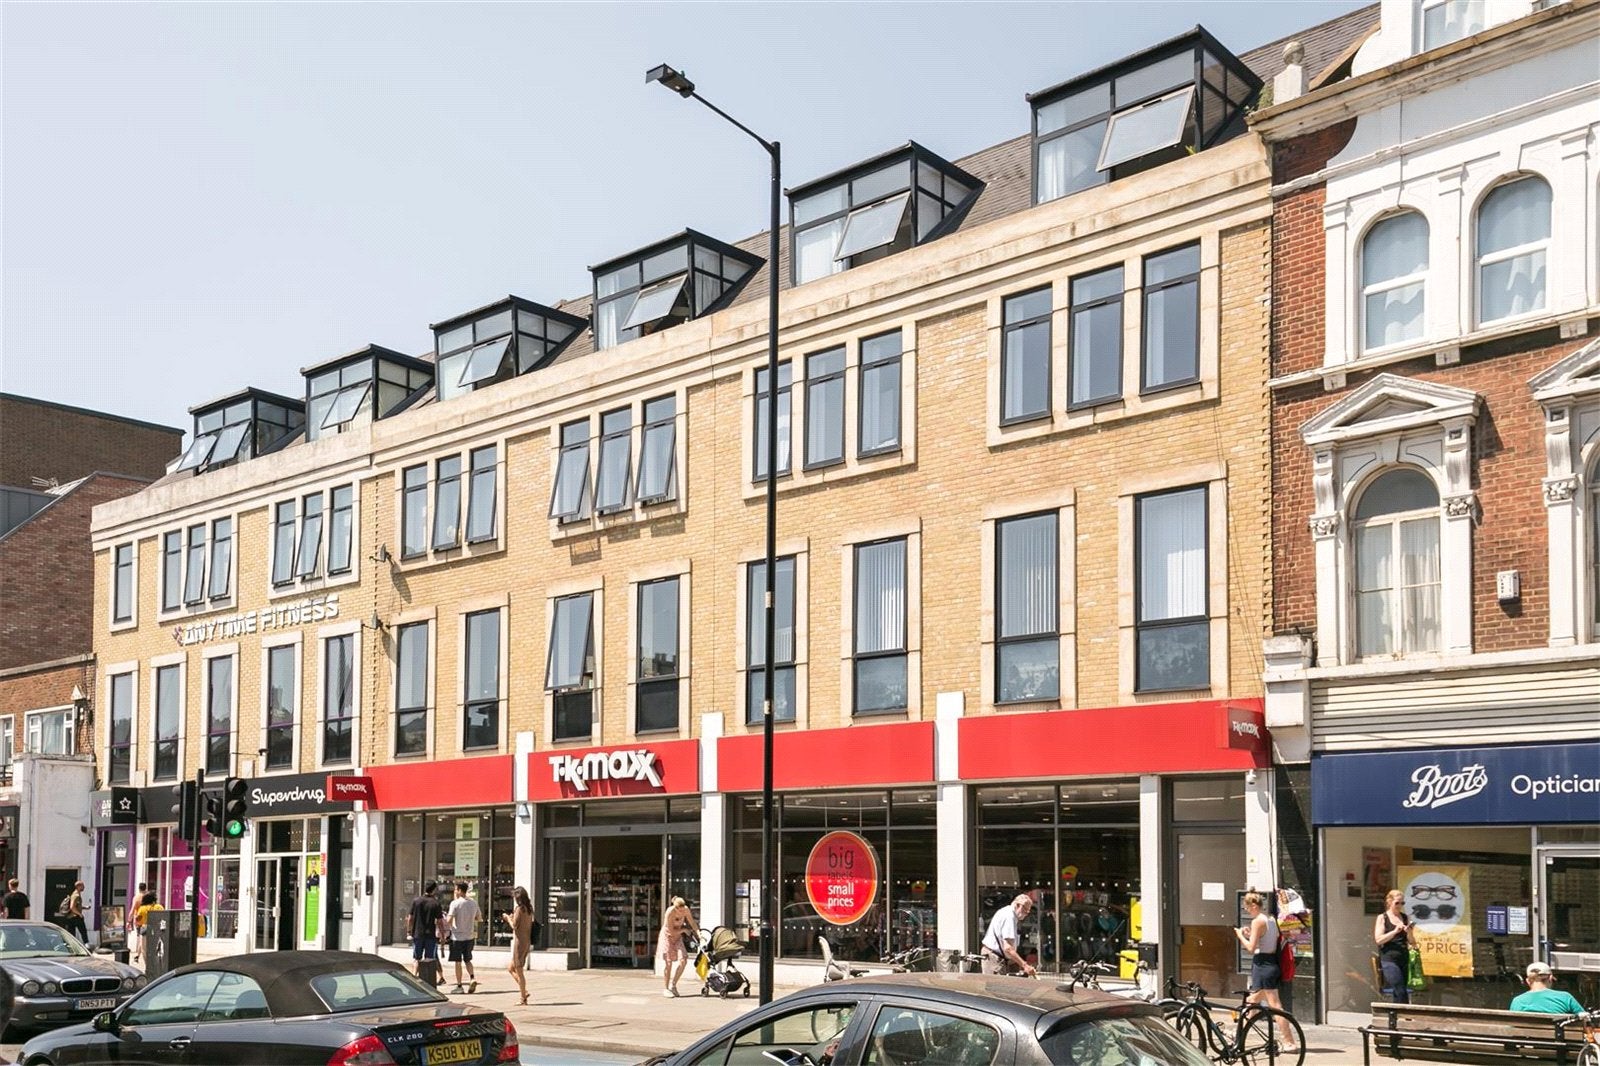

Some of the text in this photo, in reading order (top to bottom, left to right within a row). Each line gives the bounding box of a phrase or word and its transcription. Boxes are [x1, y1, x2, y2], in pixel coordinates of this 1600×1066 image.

[183, 593, 339, 645] ANYTIME FITNESS
[252, 786, 325, 806] Superdrug
[1402, 763, 1488, 809] Boots
[828, 846, 854, 869] big
[827, 882, 855, 895] small
[827, 895, 855, 909] prices
[1426, 942, 1468, 955] PRICE
[428, 1042, 481, 1062] KS08 VXH
